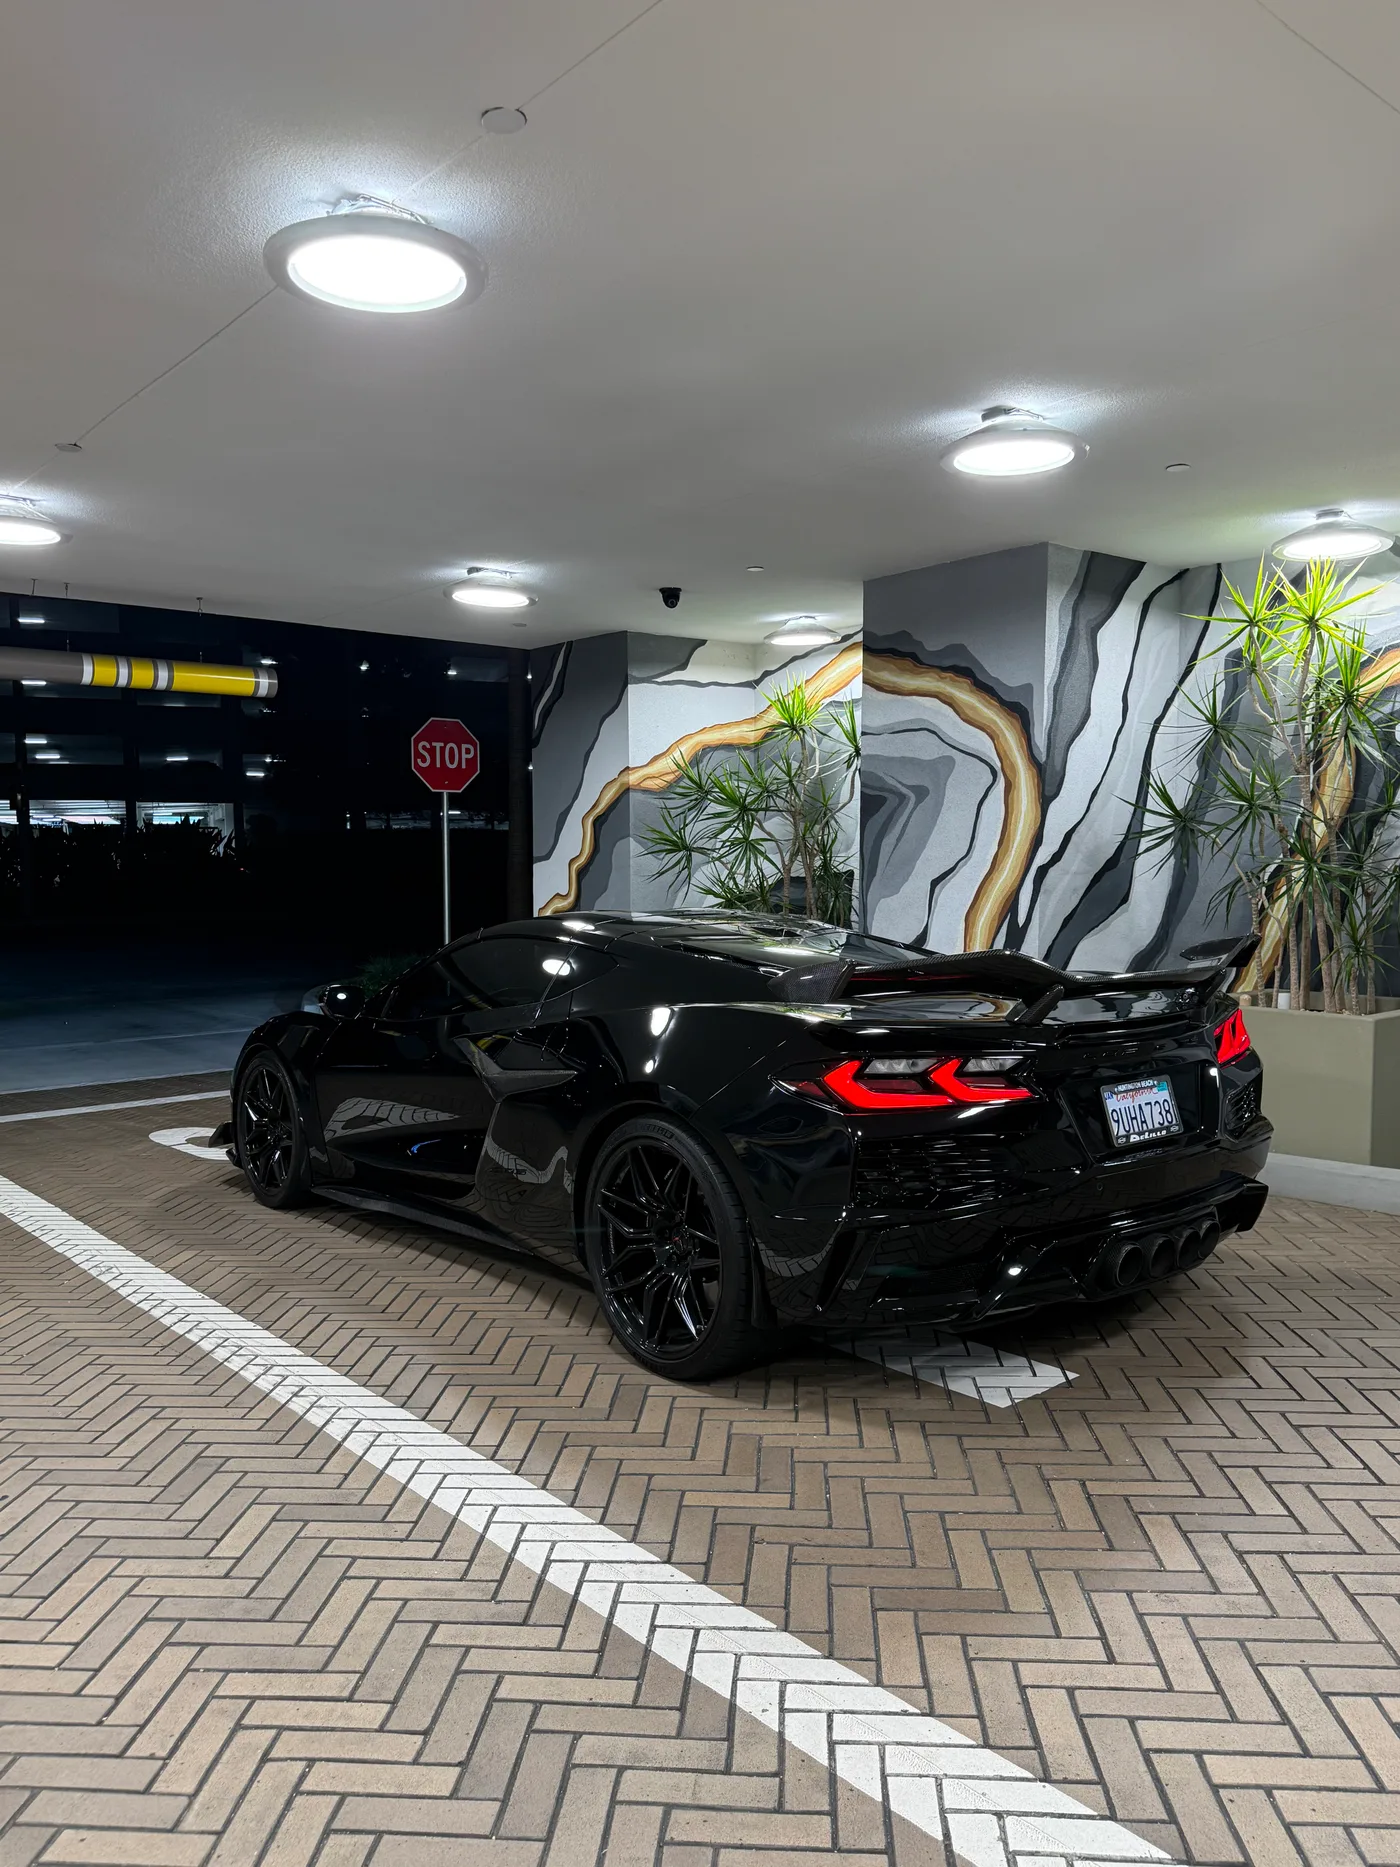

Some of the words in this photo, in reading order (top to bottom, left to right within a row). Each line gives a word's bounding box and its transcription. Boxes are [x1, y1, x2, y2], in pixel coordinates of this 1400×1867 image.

[417, 741, 474, 769] STOP
[1117, 1082, 1141, 1092] HUNTINGTON
[1110, 1099, 1173, 1136] 9UHA738
